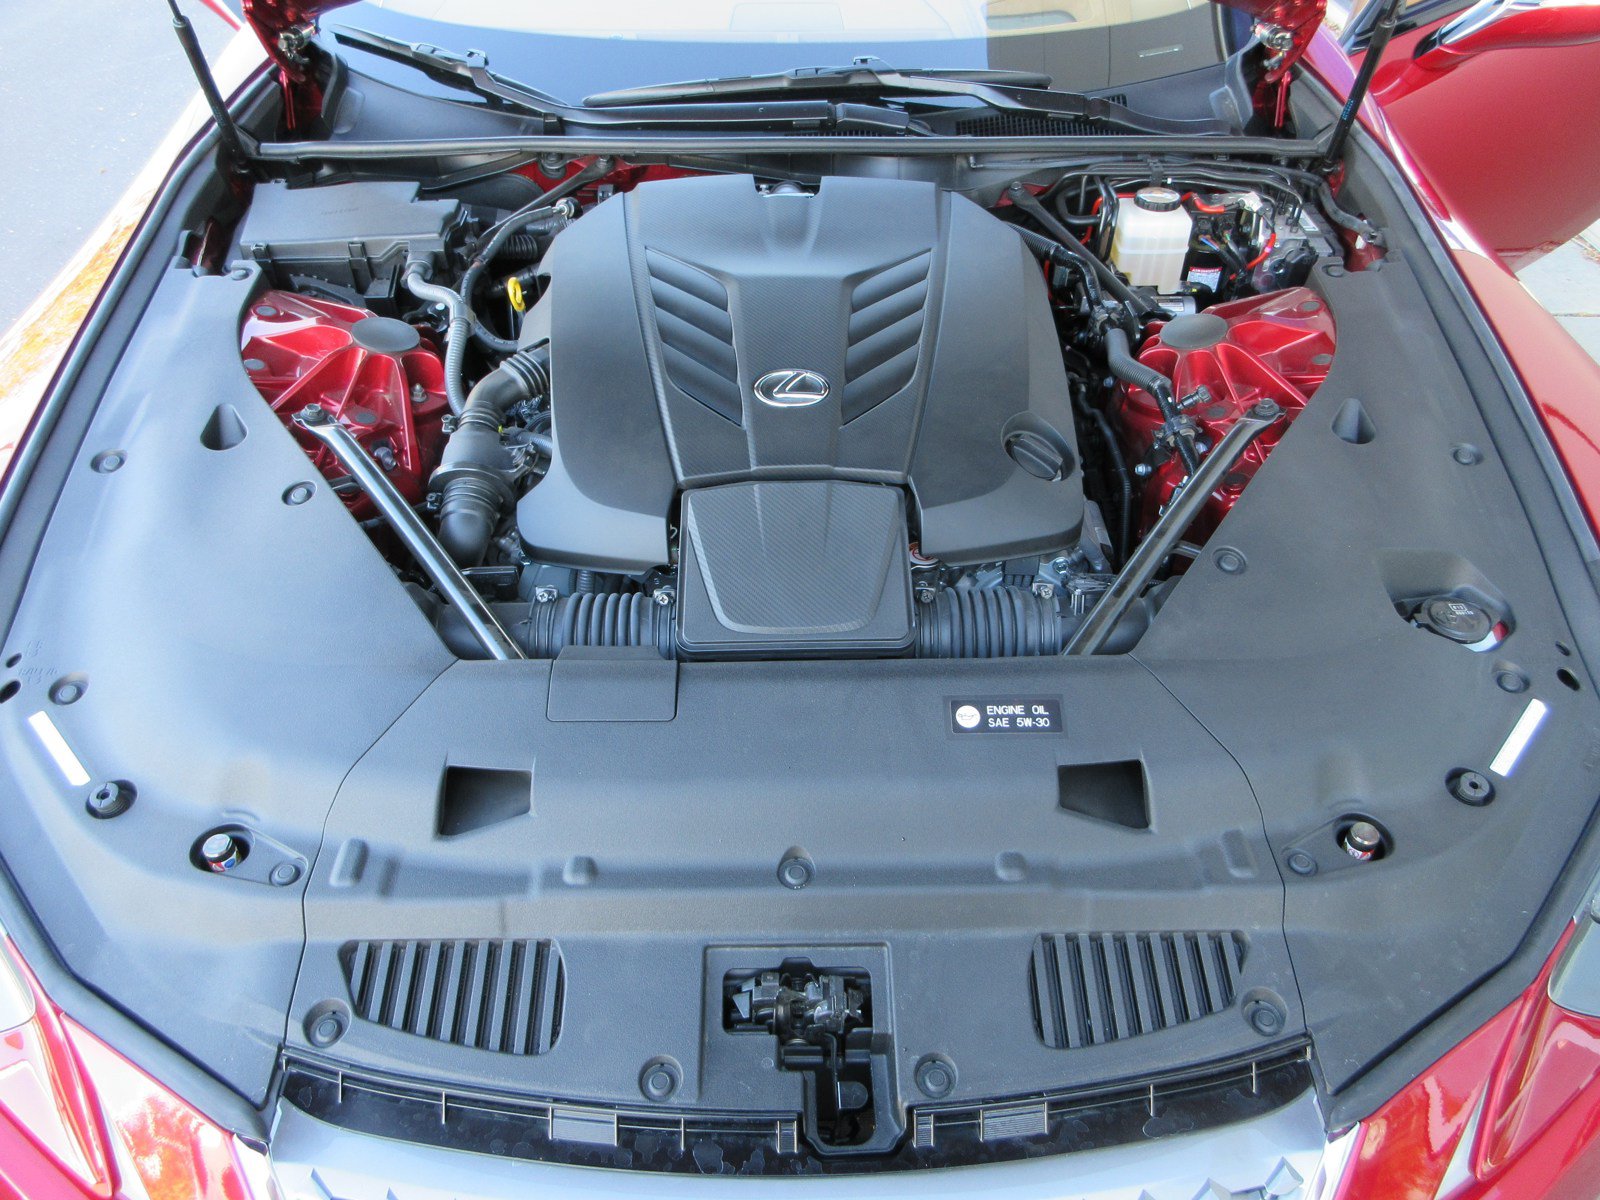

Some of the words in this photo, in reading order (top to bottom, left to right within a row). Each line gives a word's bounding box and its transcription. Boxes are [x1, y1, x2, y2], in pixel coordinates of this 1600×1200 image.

[986, 705, 1025, 715] ENGINE
[1031, 705, 1049, 715] OIL
[988, 717, 1010, 727] SAE
[1016, 717, 1050, 727] 5W-30
